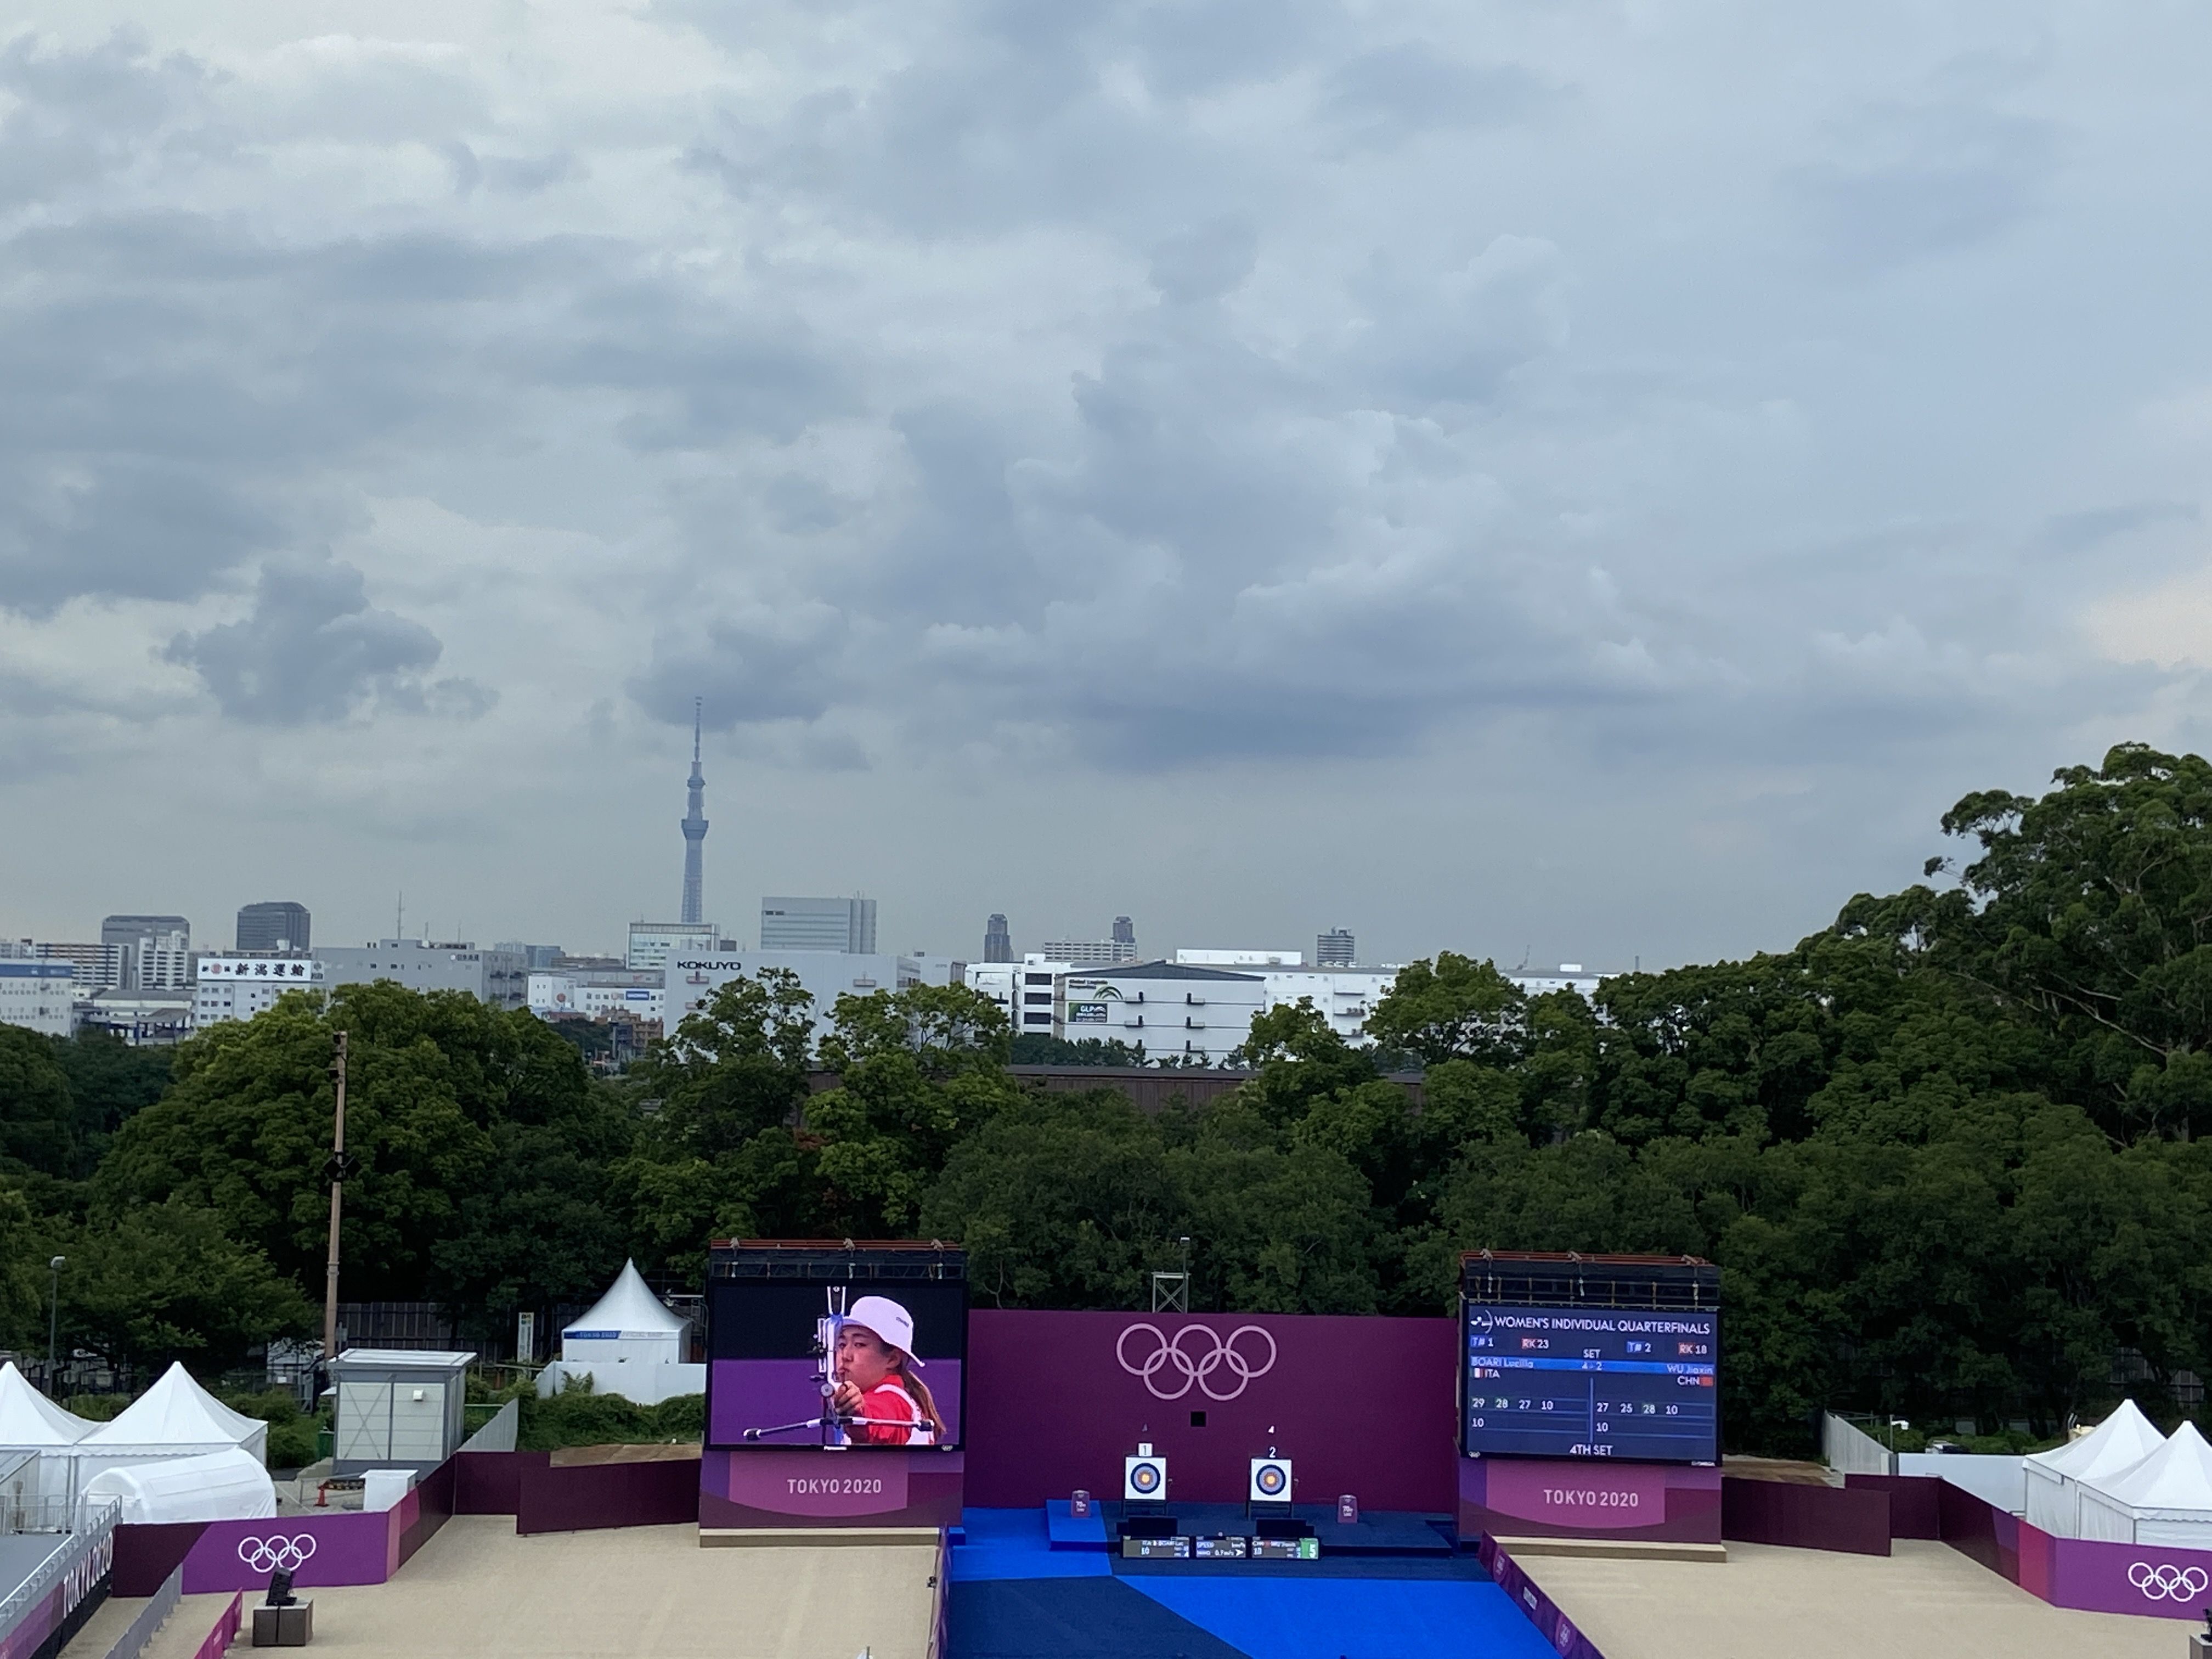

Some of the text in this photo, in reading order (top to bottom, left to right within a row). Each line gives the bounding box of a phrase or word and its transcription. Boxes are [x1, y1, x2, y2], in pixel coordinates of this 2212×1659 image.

[235, 963, 304, 977] 新潟運輸
[676, 961, 741, 970] KOKUYO
[1494, 1316, 1710, 1335] WOMEN'S INDIVIDUAL QUARTERFINALS
[1488, 1338, 1494, 1347] 1
[1537, 1339, 1549, 1349] 23
[1645, 1343, 1651, 1352] 2
[1583, 1348, 1601, 1358] SET
[1485, 1369, 1500, 1378] ITA
[1667, 1364, 1684, 1374] WU
[1677, 1375, 1700, 1386] CHN
[1472, 1398, 1554, 1410] 29 28 27 10
[1596, 1402, 1678, 1415] 27 25 28 10
[1472, 1418, 1485, 1427] 10
[1596, 1422, 1609, 1432] 10
[1268, 1446, 1276, 1458] 2
[1570, 1444, 1613, 1456] 4TH SET
[787, 1479, 882, 1494] TOKYO 2020
[1543, 1489, 1638, 1507] TOKYO 2020
